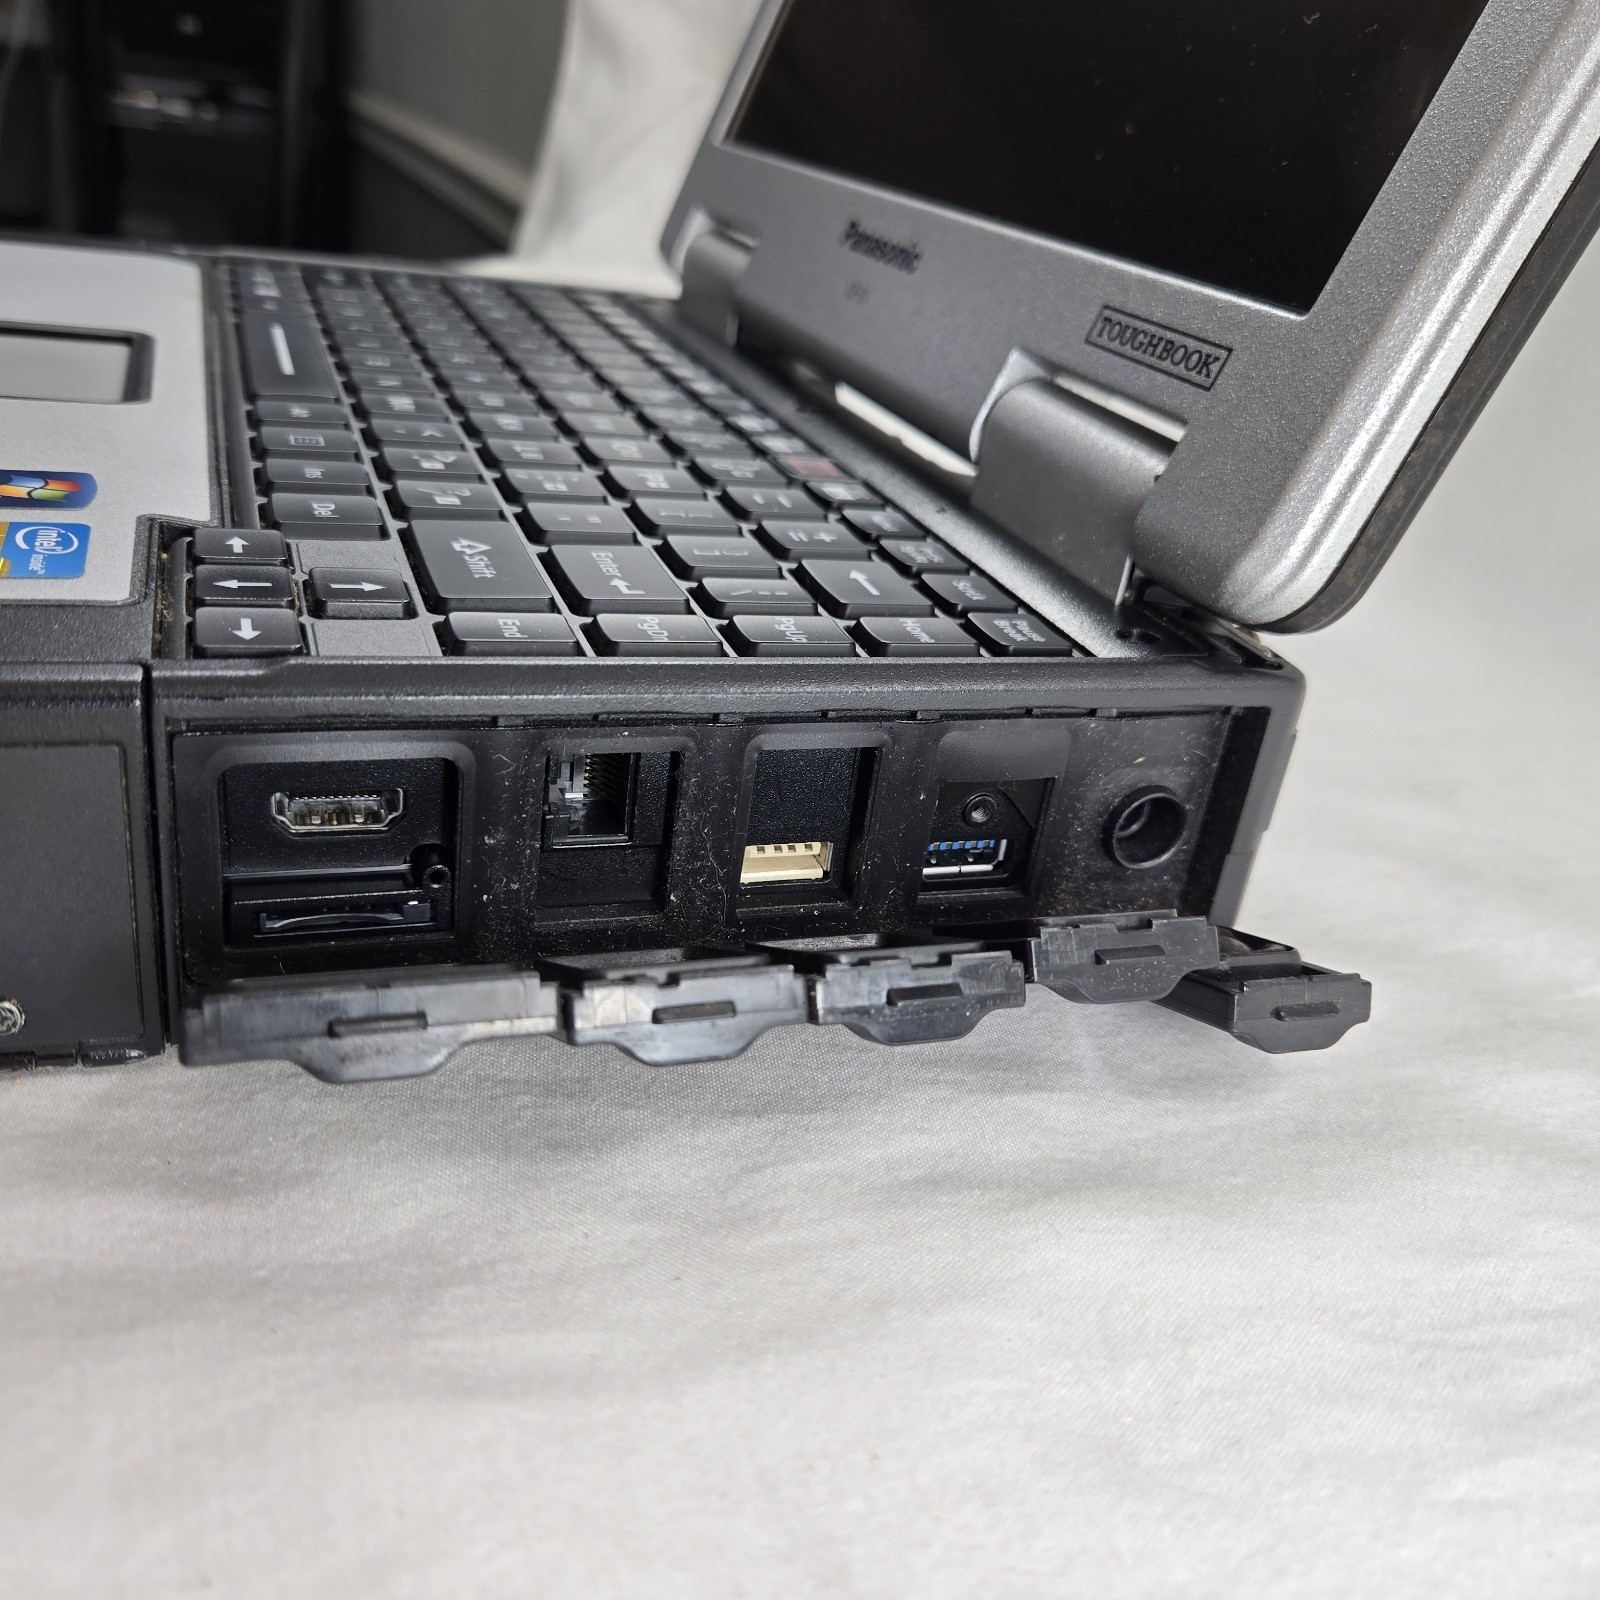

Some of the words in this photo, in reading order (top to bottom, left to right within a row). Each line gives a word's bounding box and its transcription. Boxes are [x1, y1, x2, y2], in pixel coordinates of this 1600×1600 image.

[841, 220, 922, 275] Panasonic
[1097, 317, 1220, 378] TOUGHBOOK
[304, 467, 326, 479] Ins
[312, 502, 340, 518] Del
[34, 528, 66, 552] intel
[465, 554, 497, 579] Shift
[592, 551, 622, 578] Enter
[498, 618, 528, 639] End
[773, 615, 808, 643] PgUp
[899, 618, 935, 644] Home
[993, 618, 1029, 643] Break
[1011, 619, 1046, 643] Pause
